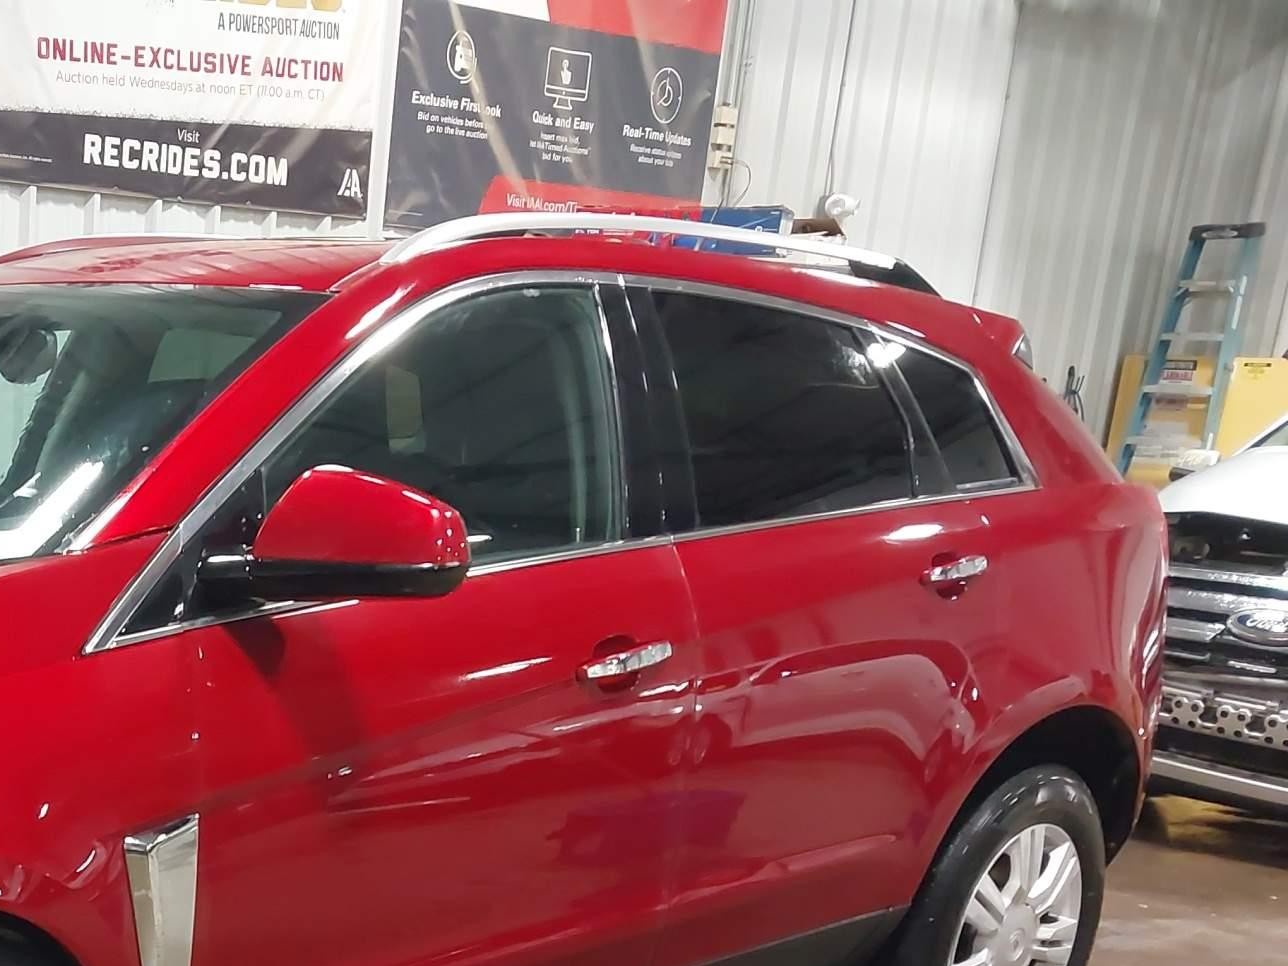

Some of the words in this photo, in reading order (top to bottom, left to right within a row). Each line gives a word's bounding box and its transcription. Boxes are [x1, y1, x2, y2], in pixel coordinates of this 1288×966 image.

[217, 12, 225, 31] A
[228, 13, 298, 36] POWERSPORT
[299, 18, 340, 40] AUCTION
[37, 36, 252, 77] ONLINE-EXCLUSIVE
[261, 56, 344, 82] AUCTION
[56, 70, 99, 85] Auction
[102, 72, 126, 88] held
[129, 76, 193, 94] Wednesdays
[195, 82, 206, 94] at
[209, 83, 236, 95] noon
[239, 83, 253, 97] ET
[308, 88, 325, 101] CT)
[411, 90, 460, 110] Exclusive
[417, 111, 430, 121] Bid
[430, 114, 439, 122] on
[532, 110, 554, 126] Quick
[555, 117, 572, 129] and
[573, 117, 595, 134] Easy
[177, 127, 201, 144] Visit
[426, 124, 435, 134] go
[436, 125, 443, 133] to
[622, 124, 665, 142] Real-Time
[665, 131, 692, 146] Updates
[83, 133, 288, 186] RECRIDES.COM
[506, 193, 525, 208] Visit
